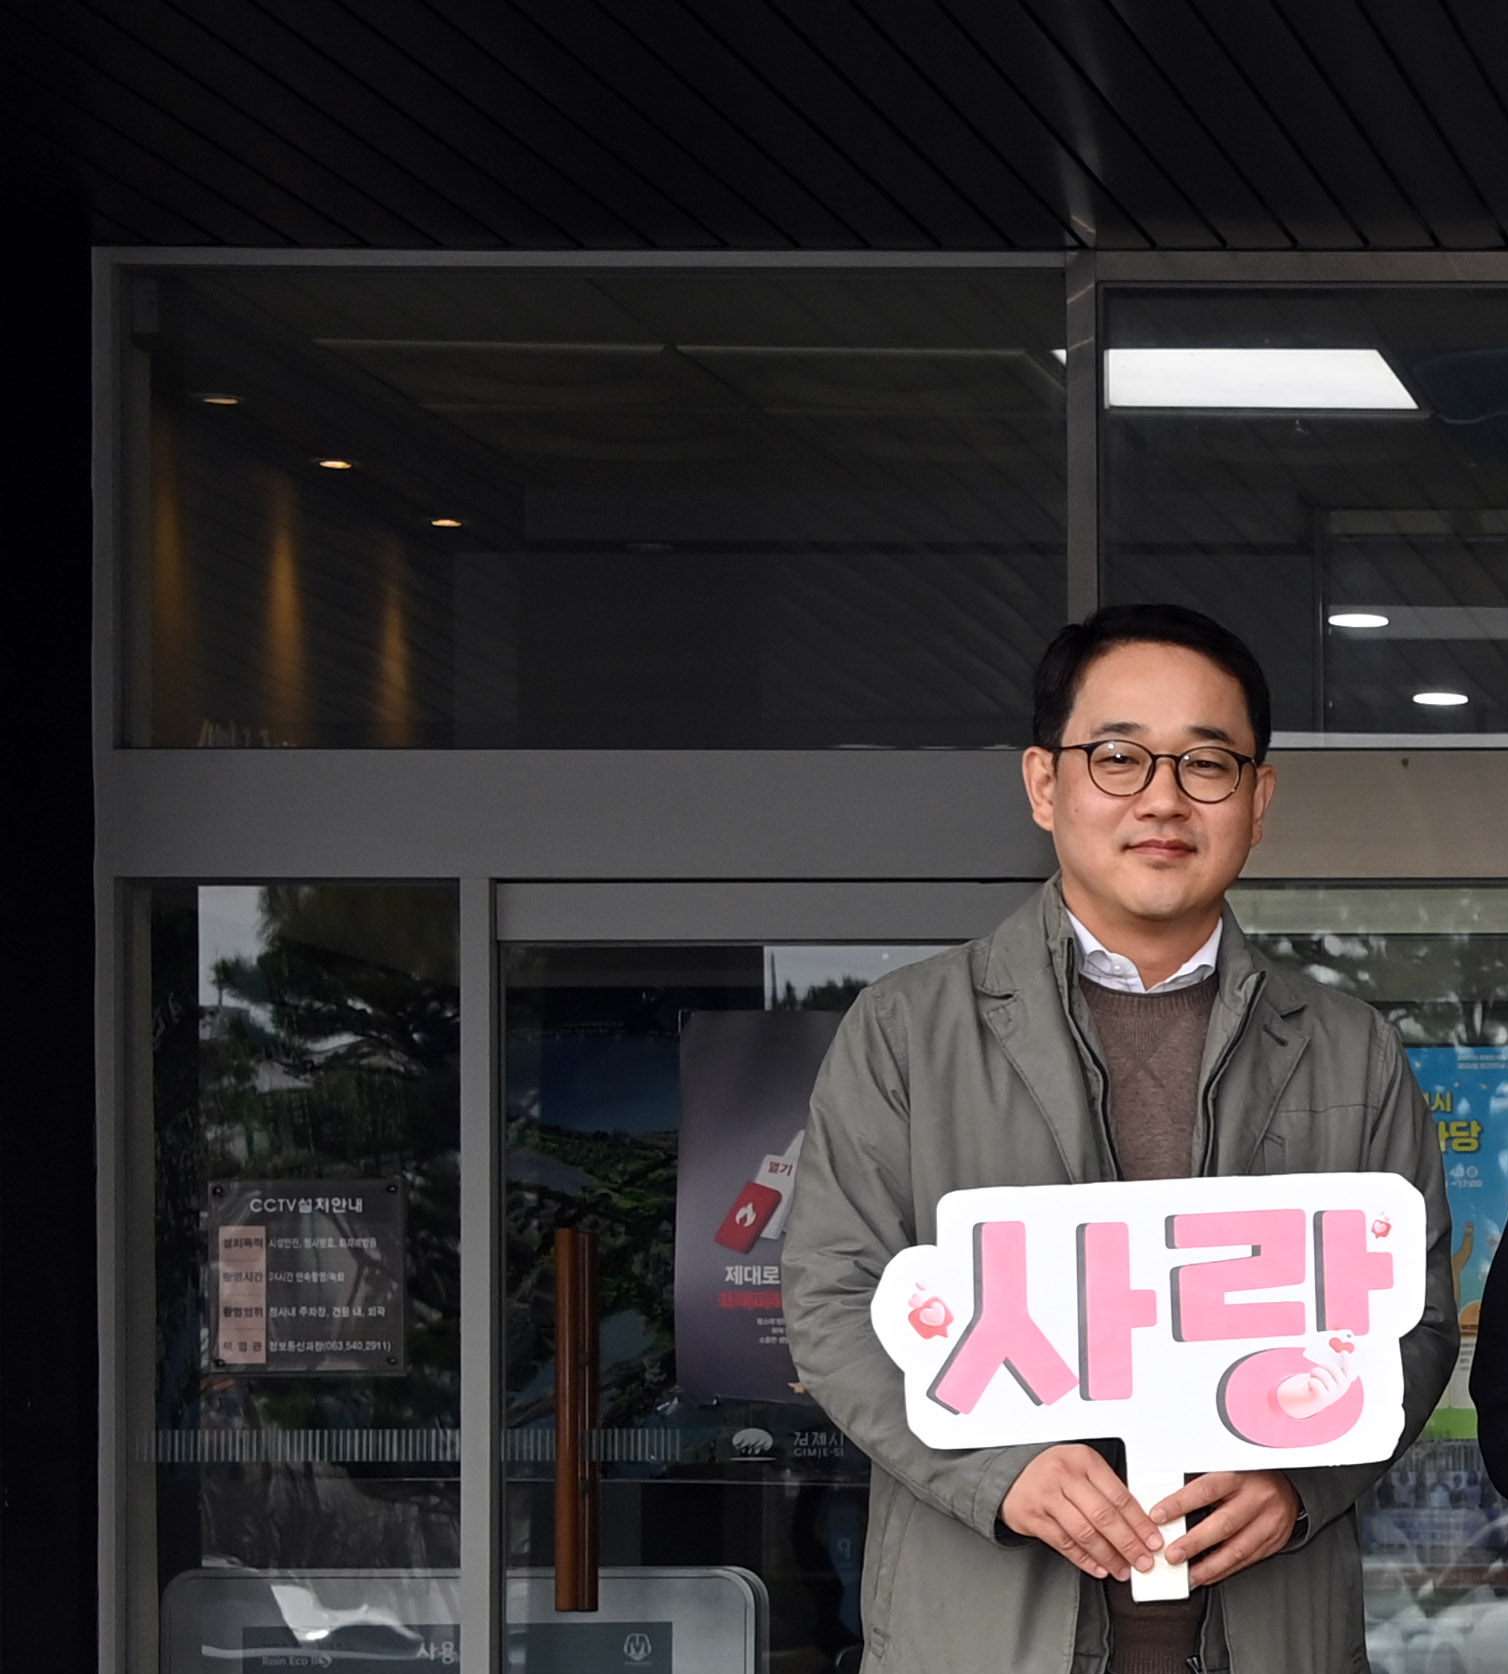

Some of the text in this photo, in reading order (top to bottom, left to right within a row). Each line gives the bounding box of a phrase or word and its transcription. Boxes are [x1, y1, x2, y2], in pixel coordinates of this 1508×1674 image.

[1423, 1091, 1453, 1112] 시
[249, 1197, 364, 1214] CCTV설치안내
[724, 1264, 781, 1286] 제대로
[926, 1208, 1395, 1449] 사랑
